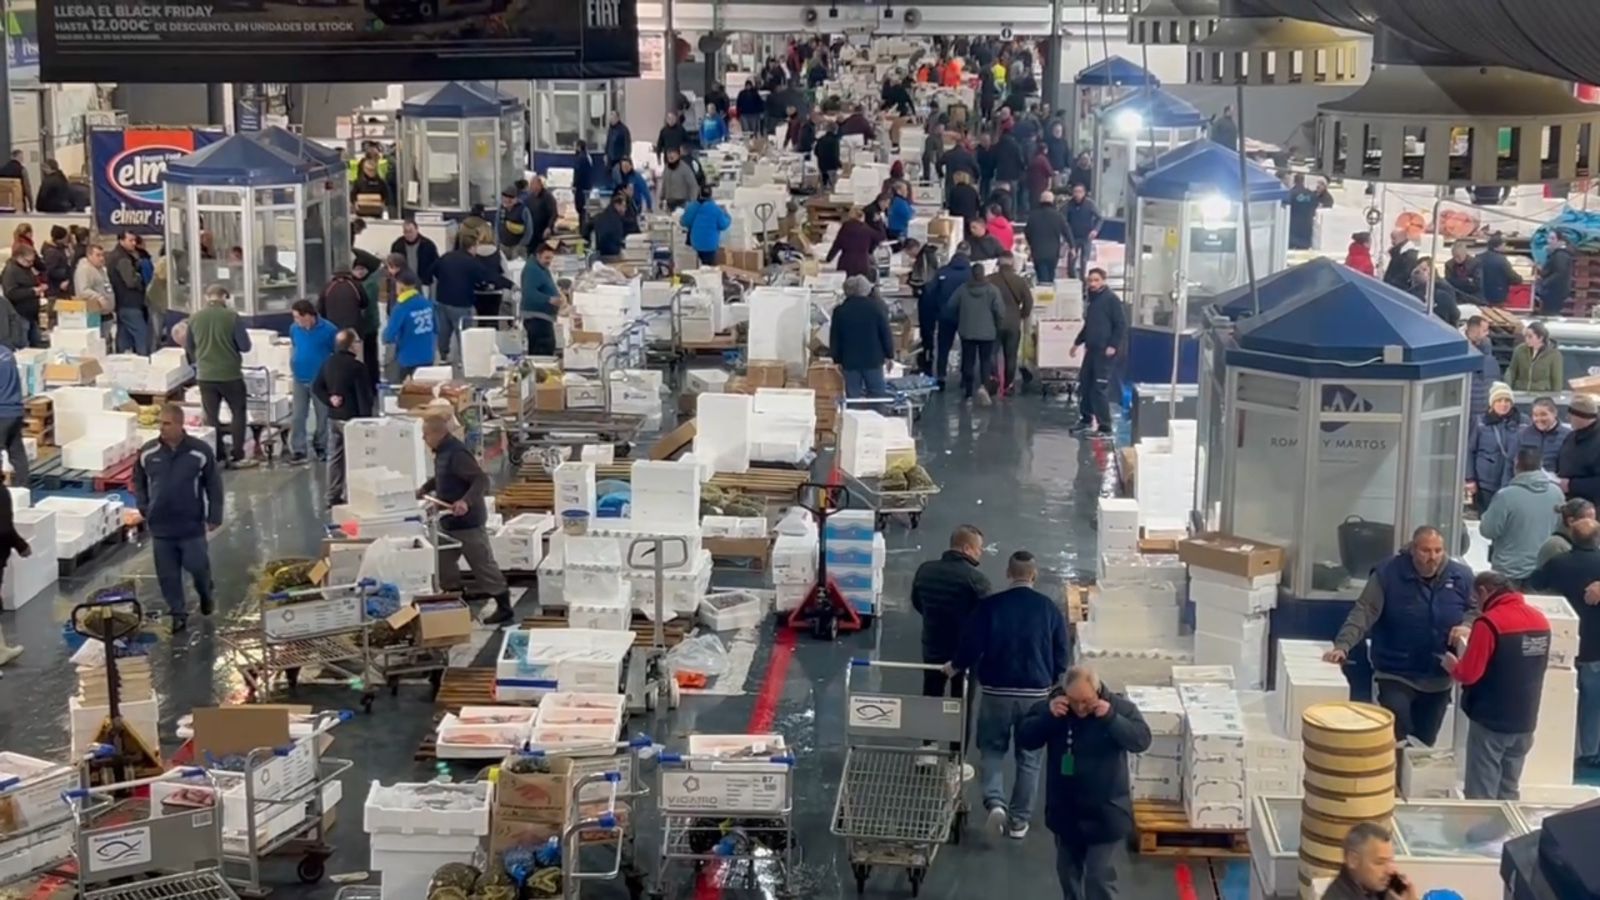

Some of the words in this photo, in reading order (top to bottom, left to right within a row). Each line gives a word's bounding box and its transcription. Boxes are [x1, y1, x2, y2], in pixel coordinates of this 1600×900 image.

[54, 5, 96, 17] LLEGA
[99, 5, 112, 17] EL
[115, 5, 161, 17] BLACK
[165, 5, 214, 17] FRIDAY
[587, 0, 621, 27] FIAT
[55, 22, 89, 31] HASTA
[155, 22, 167, 31] DE
[169, 22, 234, 32] DESCUENTO,
[235, 22, 248, 31] EN
[250, 22, 300, 31] UNIDADES
[304, 22, 317, 31] DE
[319, 22, 354, 31] STOCK
[118, 156, 167, 186] elm
[110, 202, 153, 225] elmar
[1269, 437, 1299, 447] ROM
[1322, 439, 1333, 449] Y
[1335, 439, 1387, 450] MARTOS
